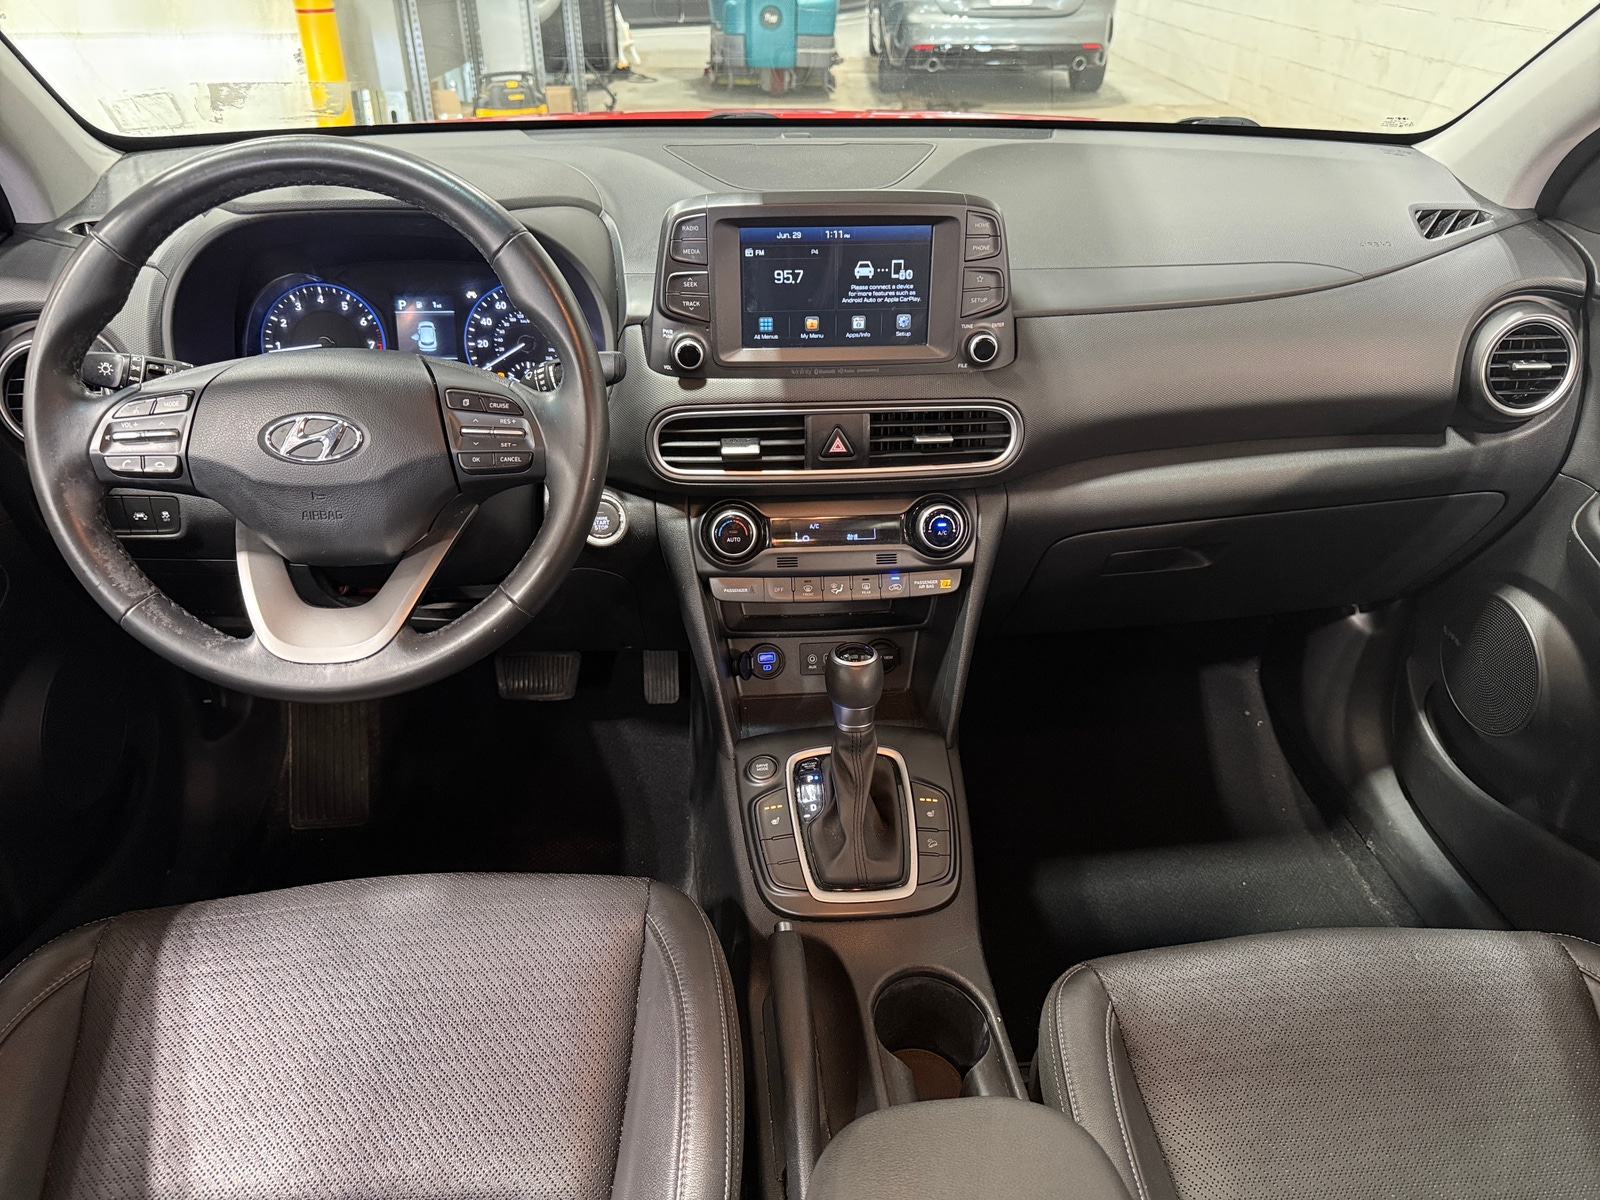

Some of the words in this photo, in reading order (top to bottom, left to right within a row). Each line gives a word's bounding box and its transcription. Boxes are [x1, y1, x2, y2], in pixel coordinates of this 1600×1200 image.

[776, 231, 791, 239] Jun.
[792, 231, 802, 239] 29
[825, 230, 843, 239] 1:11
[774, 270, 804, 284] 95.7
[317, 295, 324, 304] 4
[295, 302, 302, 311] 3
[341, 302, 348, 311] 5
[397, 299, 407, 310] P
[495, 301, 507, 310] 60
[280, 319, 287, 327] 2
[360, 317, 367, 326] 6
[480, 317, 492, 326] 40
[895, 330, 912, 338] Setup
[367, 340, 375, 349] 7
[477, 339, 489, 348] 20
[301, 510, 343, 521] AIRBAG
[807, 775, 814, 783] P
[809, 803, 817, 812] D
